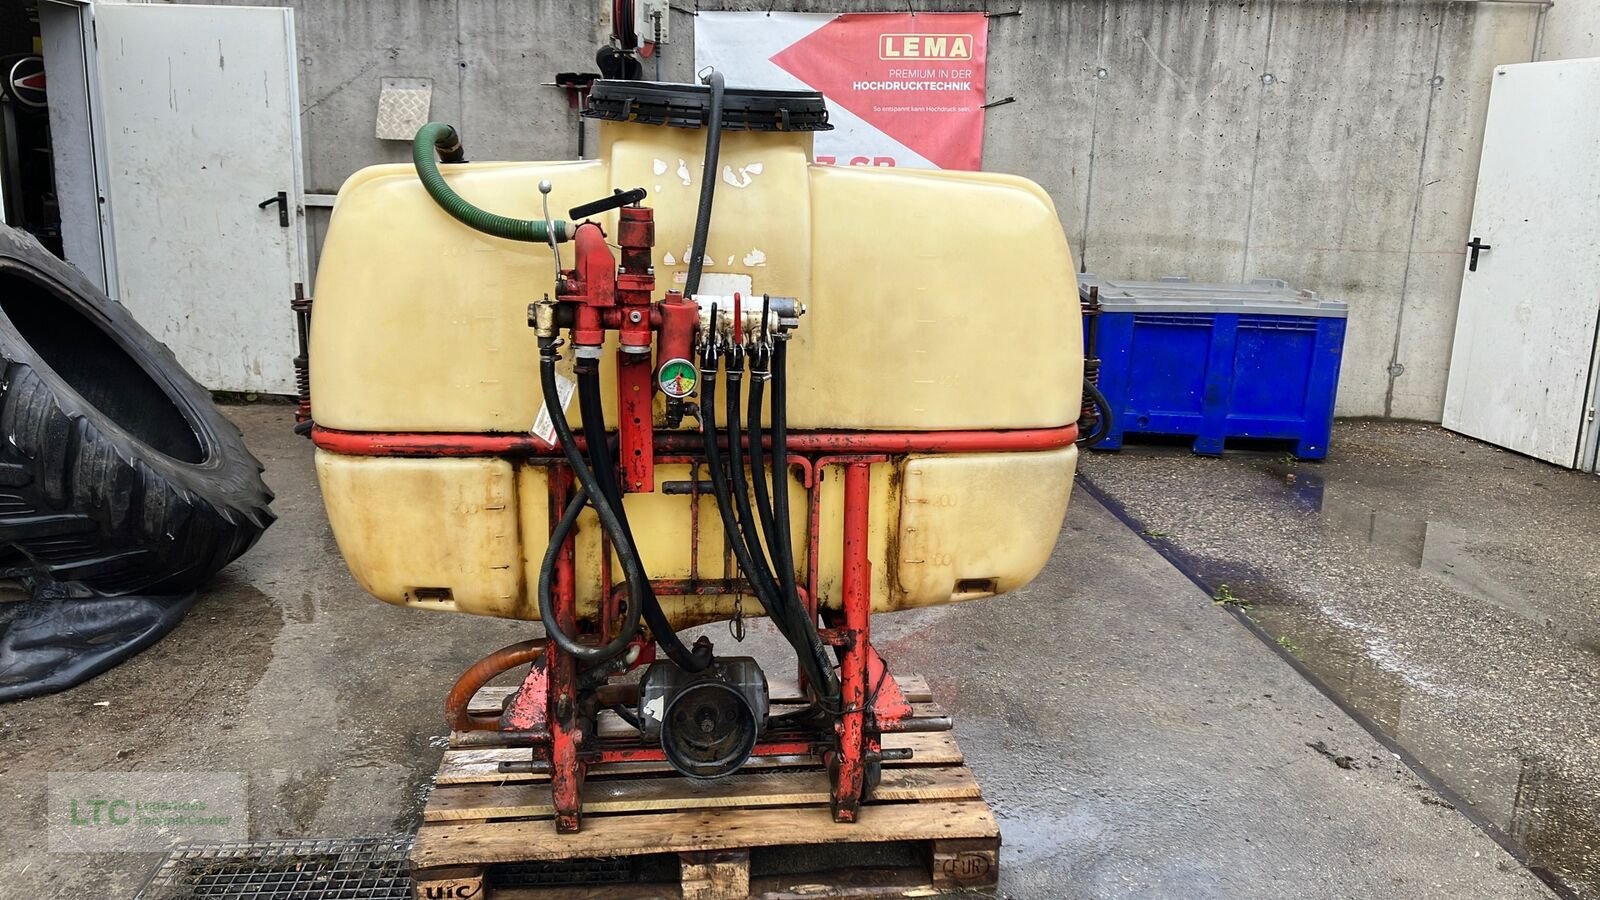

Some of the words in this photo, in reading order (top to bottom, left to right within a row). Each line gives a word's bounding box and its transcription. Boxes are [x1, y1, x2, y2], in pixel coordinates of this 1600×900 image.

[885, 36, 968, 58] LEMA
[889, 69, 936, 79] PREMIUM
[938, 69, 949, 79] IN
[951, 69, 972, 79] DER
[853, 81, 971, 91] HOCHDRUCKTECHNIK
